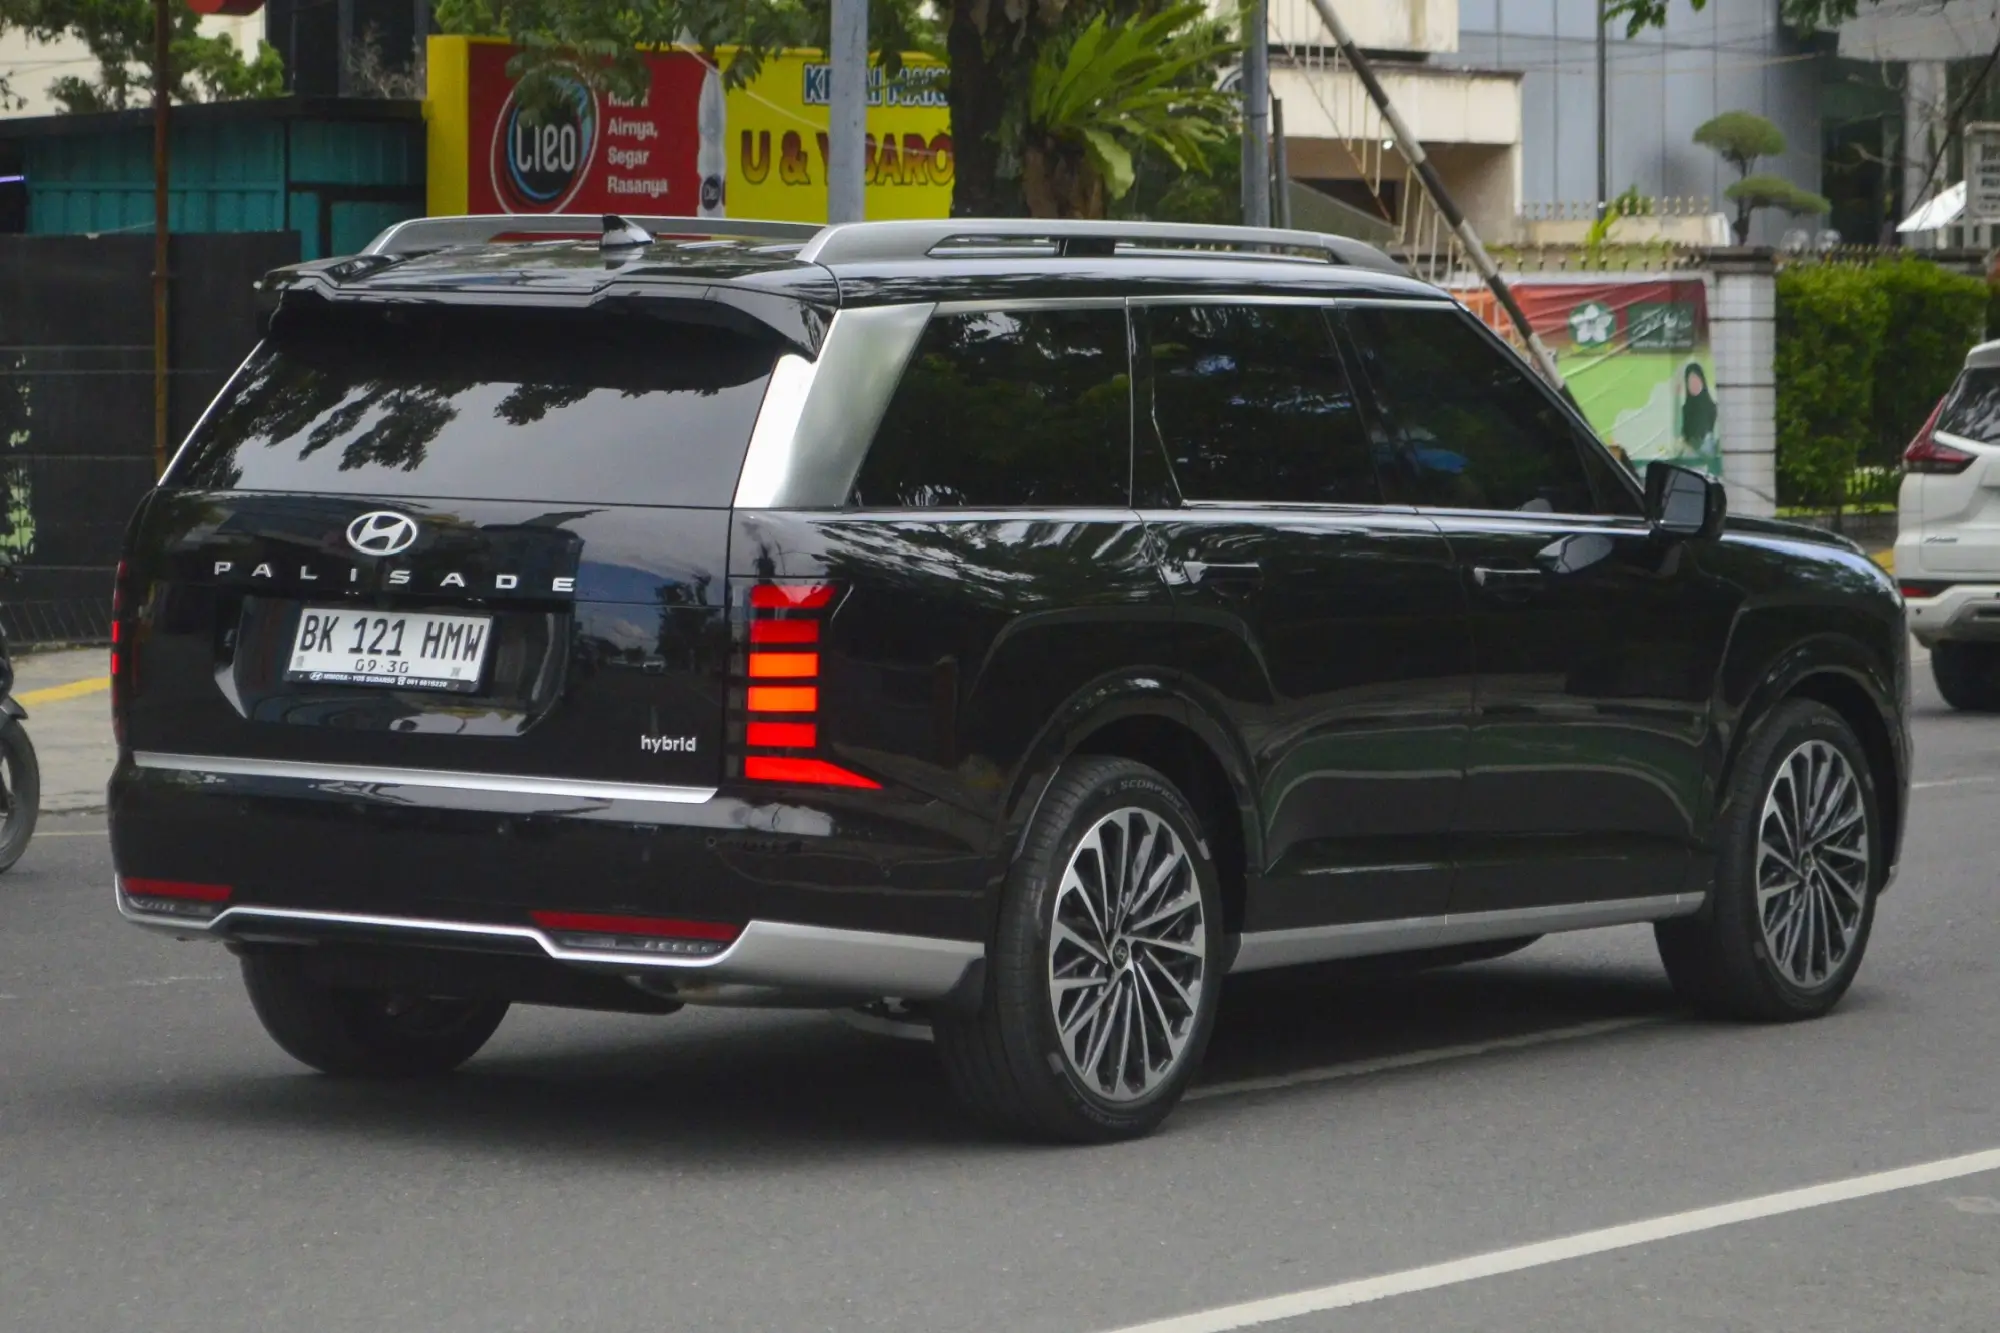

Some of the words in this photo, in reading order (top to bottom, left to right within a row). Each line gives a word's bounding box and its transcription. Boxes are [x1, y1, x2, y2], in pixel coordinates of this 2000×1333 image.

[608, 117, 658, 141] Airnya,
[608, 147, 650, 169] Segar
[607, 176, 669, 198] Rasanya
[214, 561, 575, 592] PALISADE
[299, 614, 340, 653] BK
[347, 617, 407, 657] 121
[419, 620, 485, 661] HMW
[641, 734, 697, 754] hybrid
